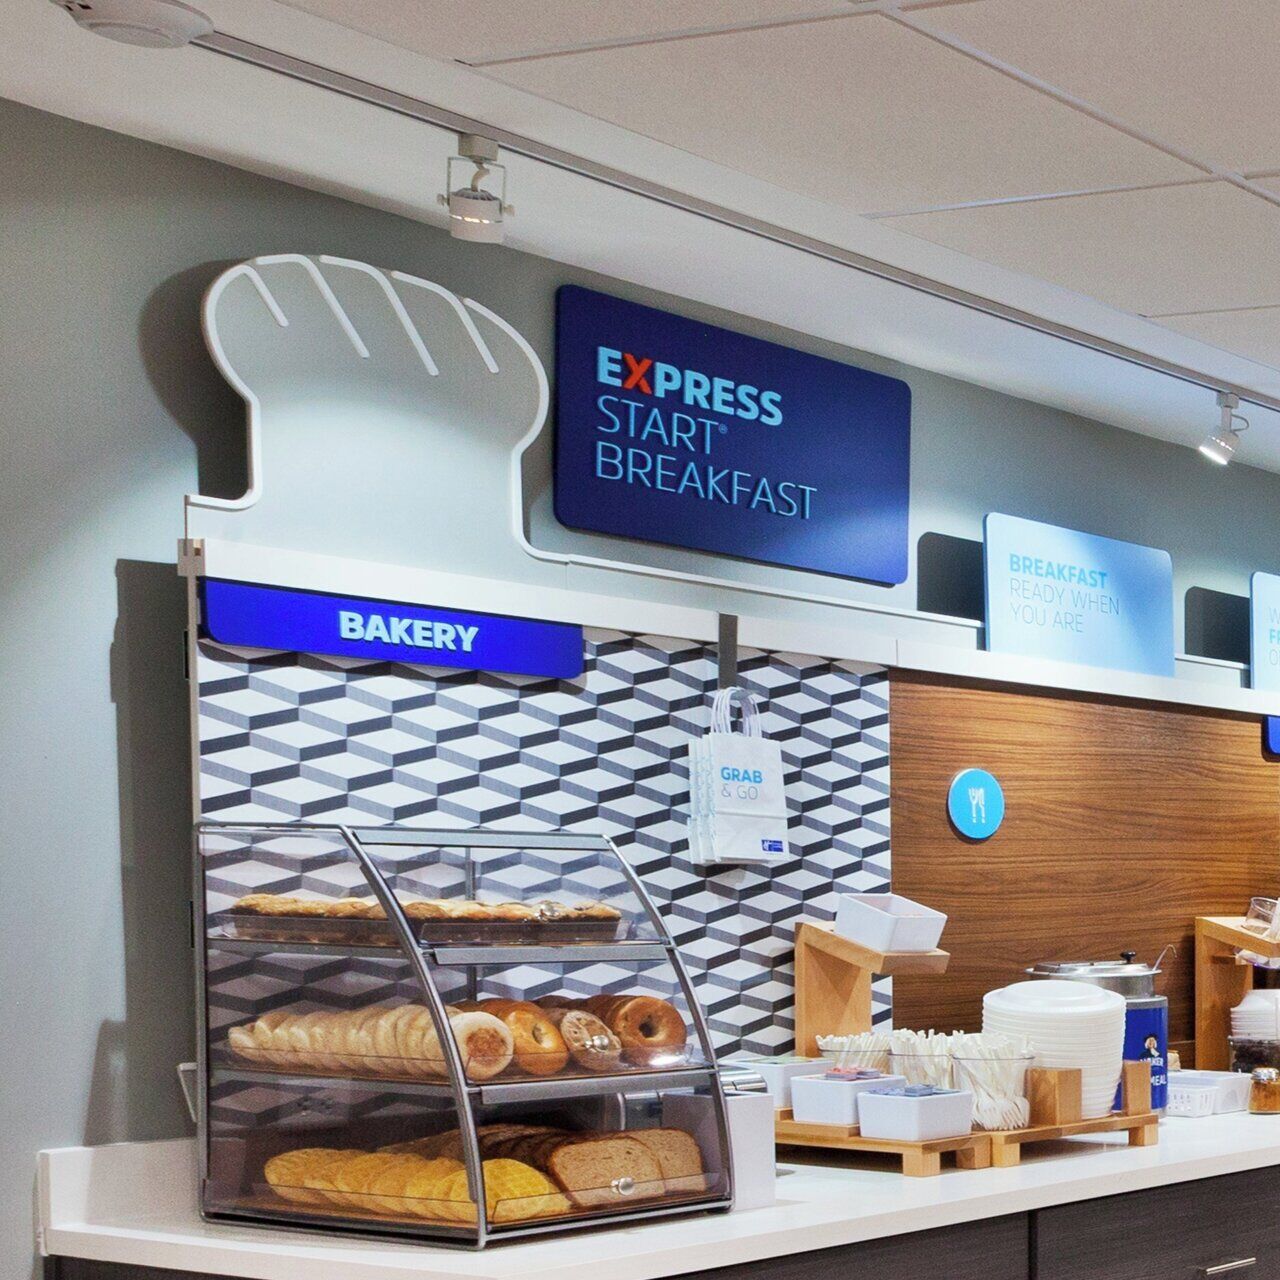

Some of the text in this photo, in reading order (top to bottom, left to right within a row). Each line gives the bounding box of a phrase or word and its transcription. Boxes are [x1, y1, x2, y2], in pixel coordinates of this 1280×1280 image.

[597, 346, 783, 426] EXPRESS
[596, 441, 818, 519] BREAKFAST
[1009, 553, 1107, 589] BREAKFAST
[1010, 578, 1119, 616] READY WHEN
[339, 610, 479, 652] BAKERY
[1010, 602, 1084, 633] YOU ARE
[720, 766, 763, 783] GRAB
[721, 783, 758, 800] & GO
